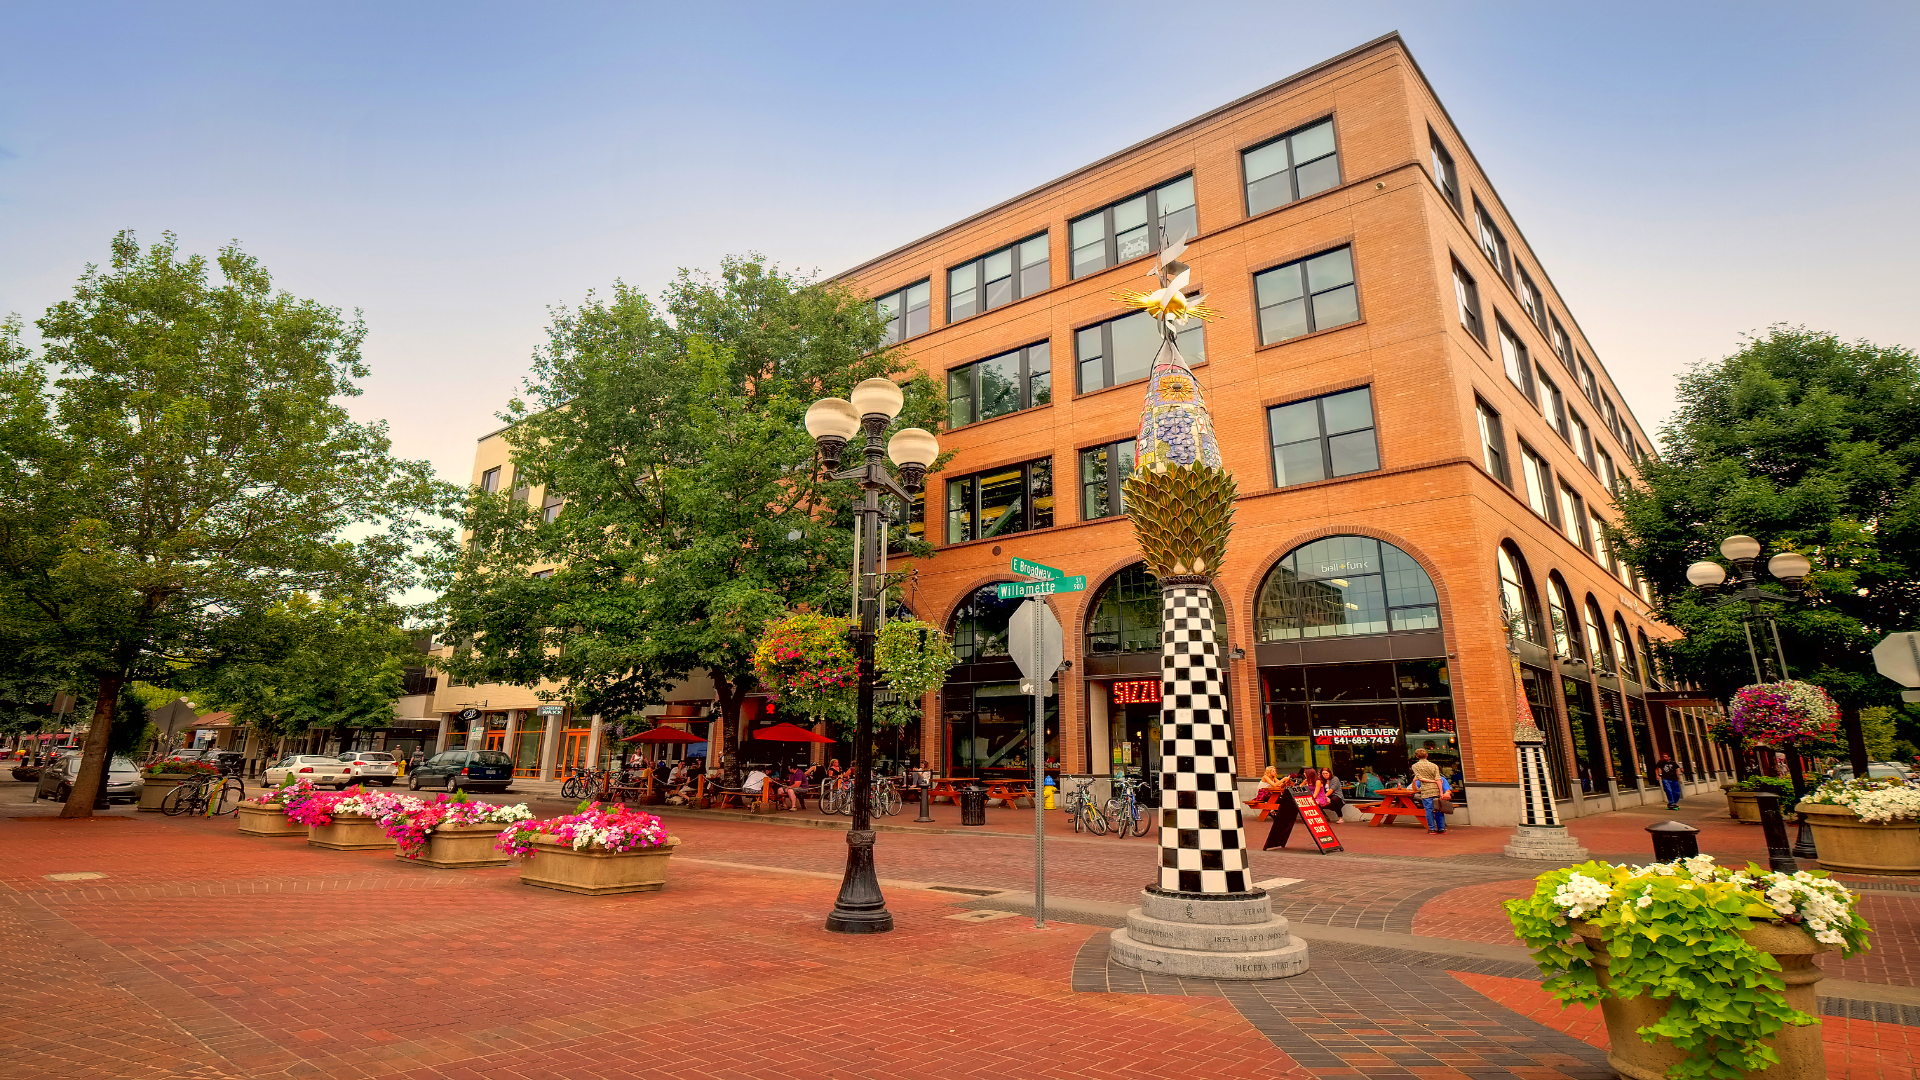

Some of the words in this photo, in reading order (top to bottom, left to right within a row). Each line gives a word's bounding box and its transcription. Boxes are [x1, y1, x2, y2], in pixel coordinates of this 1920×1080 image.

[1013, 559, 1018, 571] E
[1020, 561, 1052, 580] Broadway
[1001, 582, 1056, 597] Willamette
[1313, 728, 1333, 737] LATE
[1333, 728, 1358, 737] NIGHT
[1360, 728, 1400, 736] DELIVERY
[1334, 737, 1397, 745] 541-683-7437
[1303, 809, 1319, 817] PIZZA
[1313, 825, 1328, 833] SLICE
[1236, 964, 1268, 972] HECETA
[1271, 962, 1289, 970] HEAD
